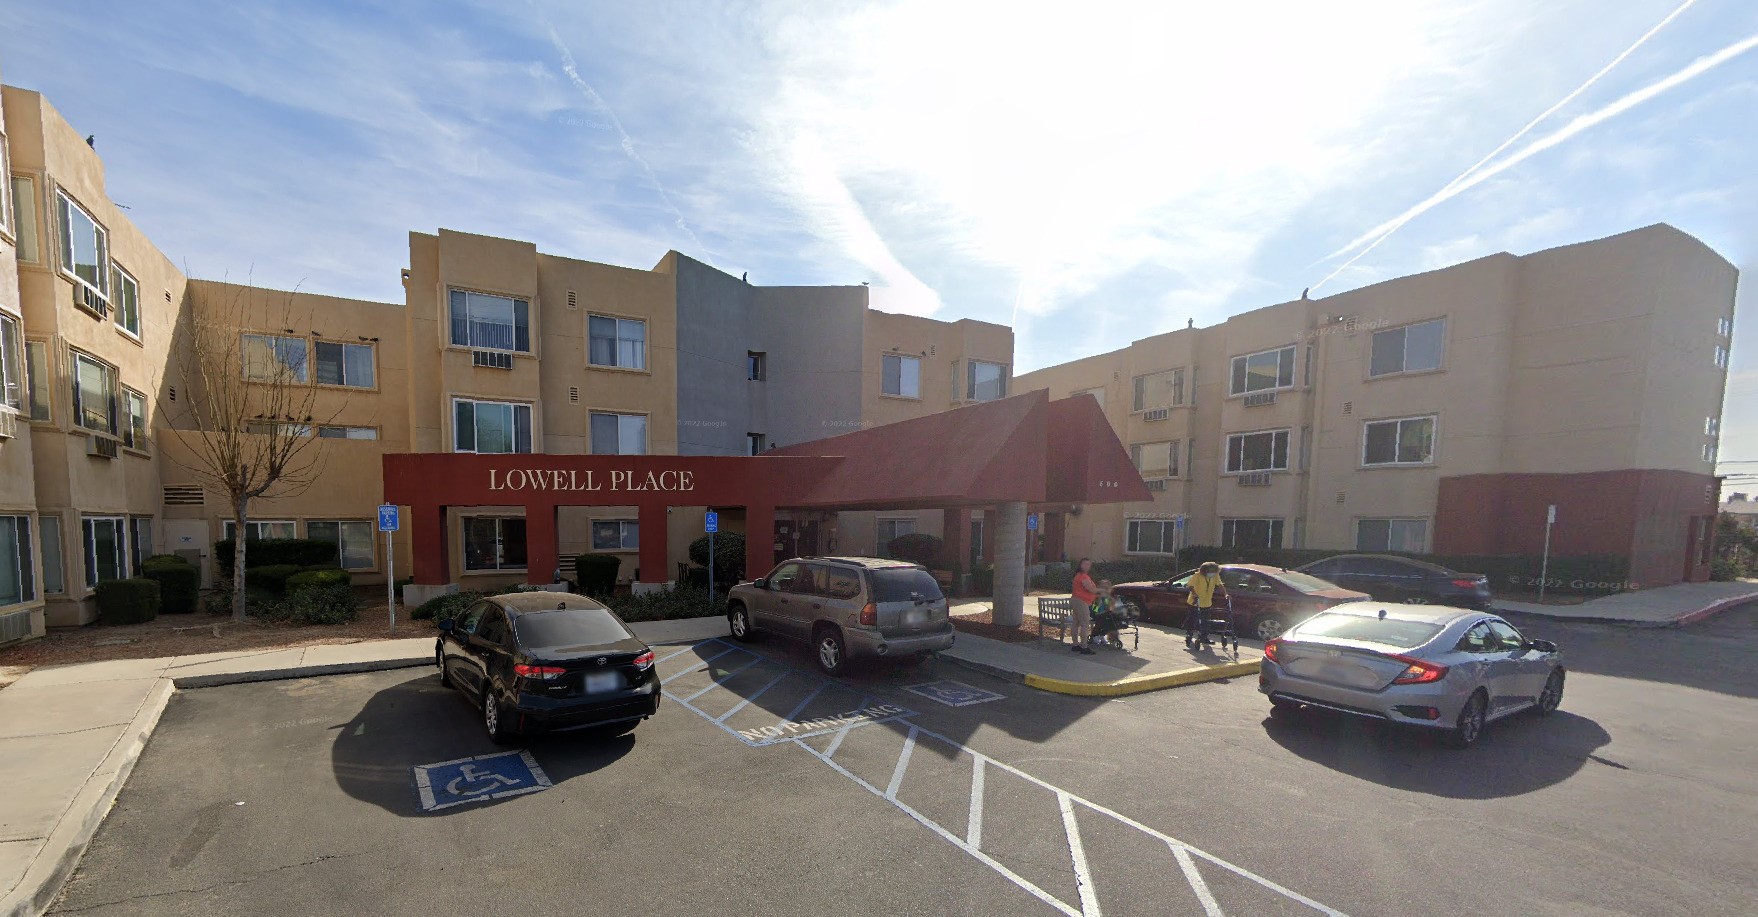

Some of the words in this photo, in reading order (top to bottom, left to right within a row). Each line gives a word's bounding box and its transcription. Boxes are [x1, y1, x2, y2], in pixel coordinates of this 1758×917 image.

[488, 469, 602, 491] LOWELL
[609, 469, 695, 491] PLACE
[736, 725, 783, 742] NO
